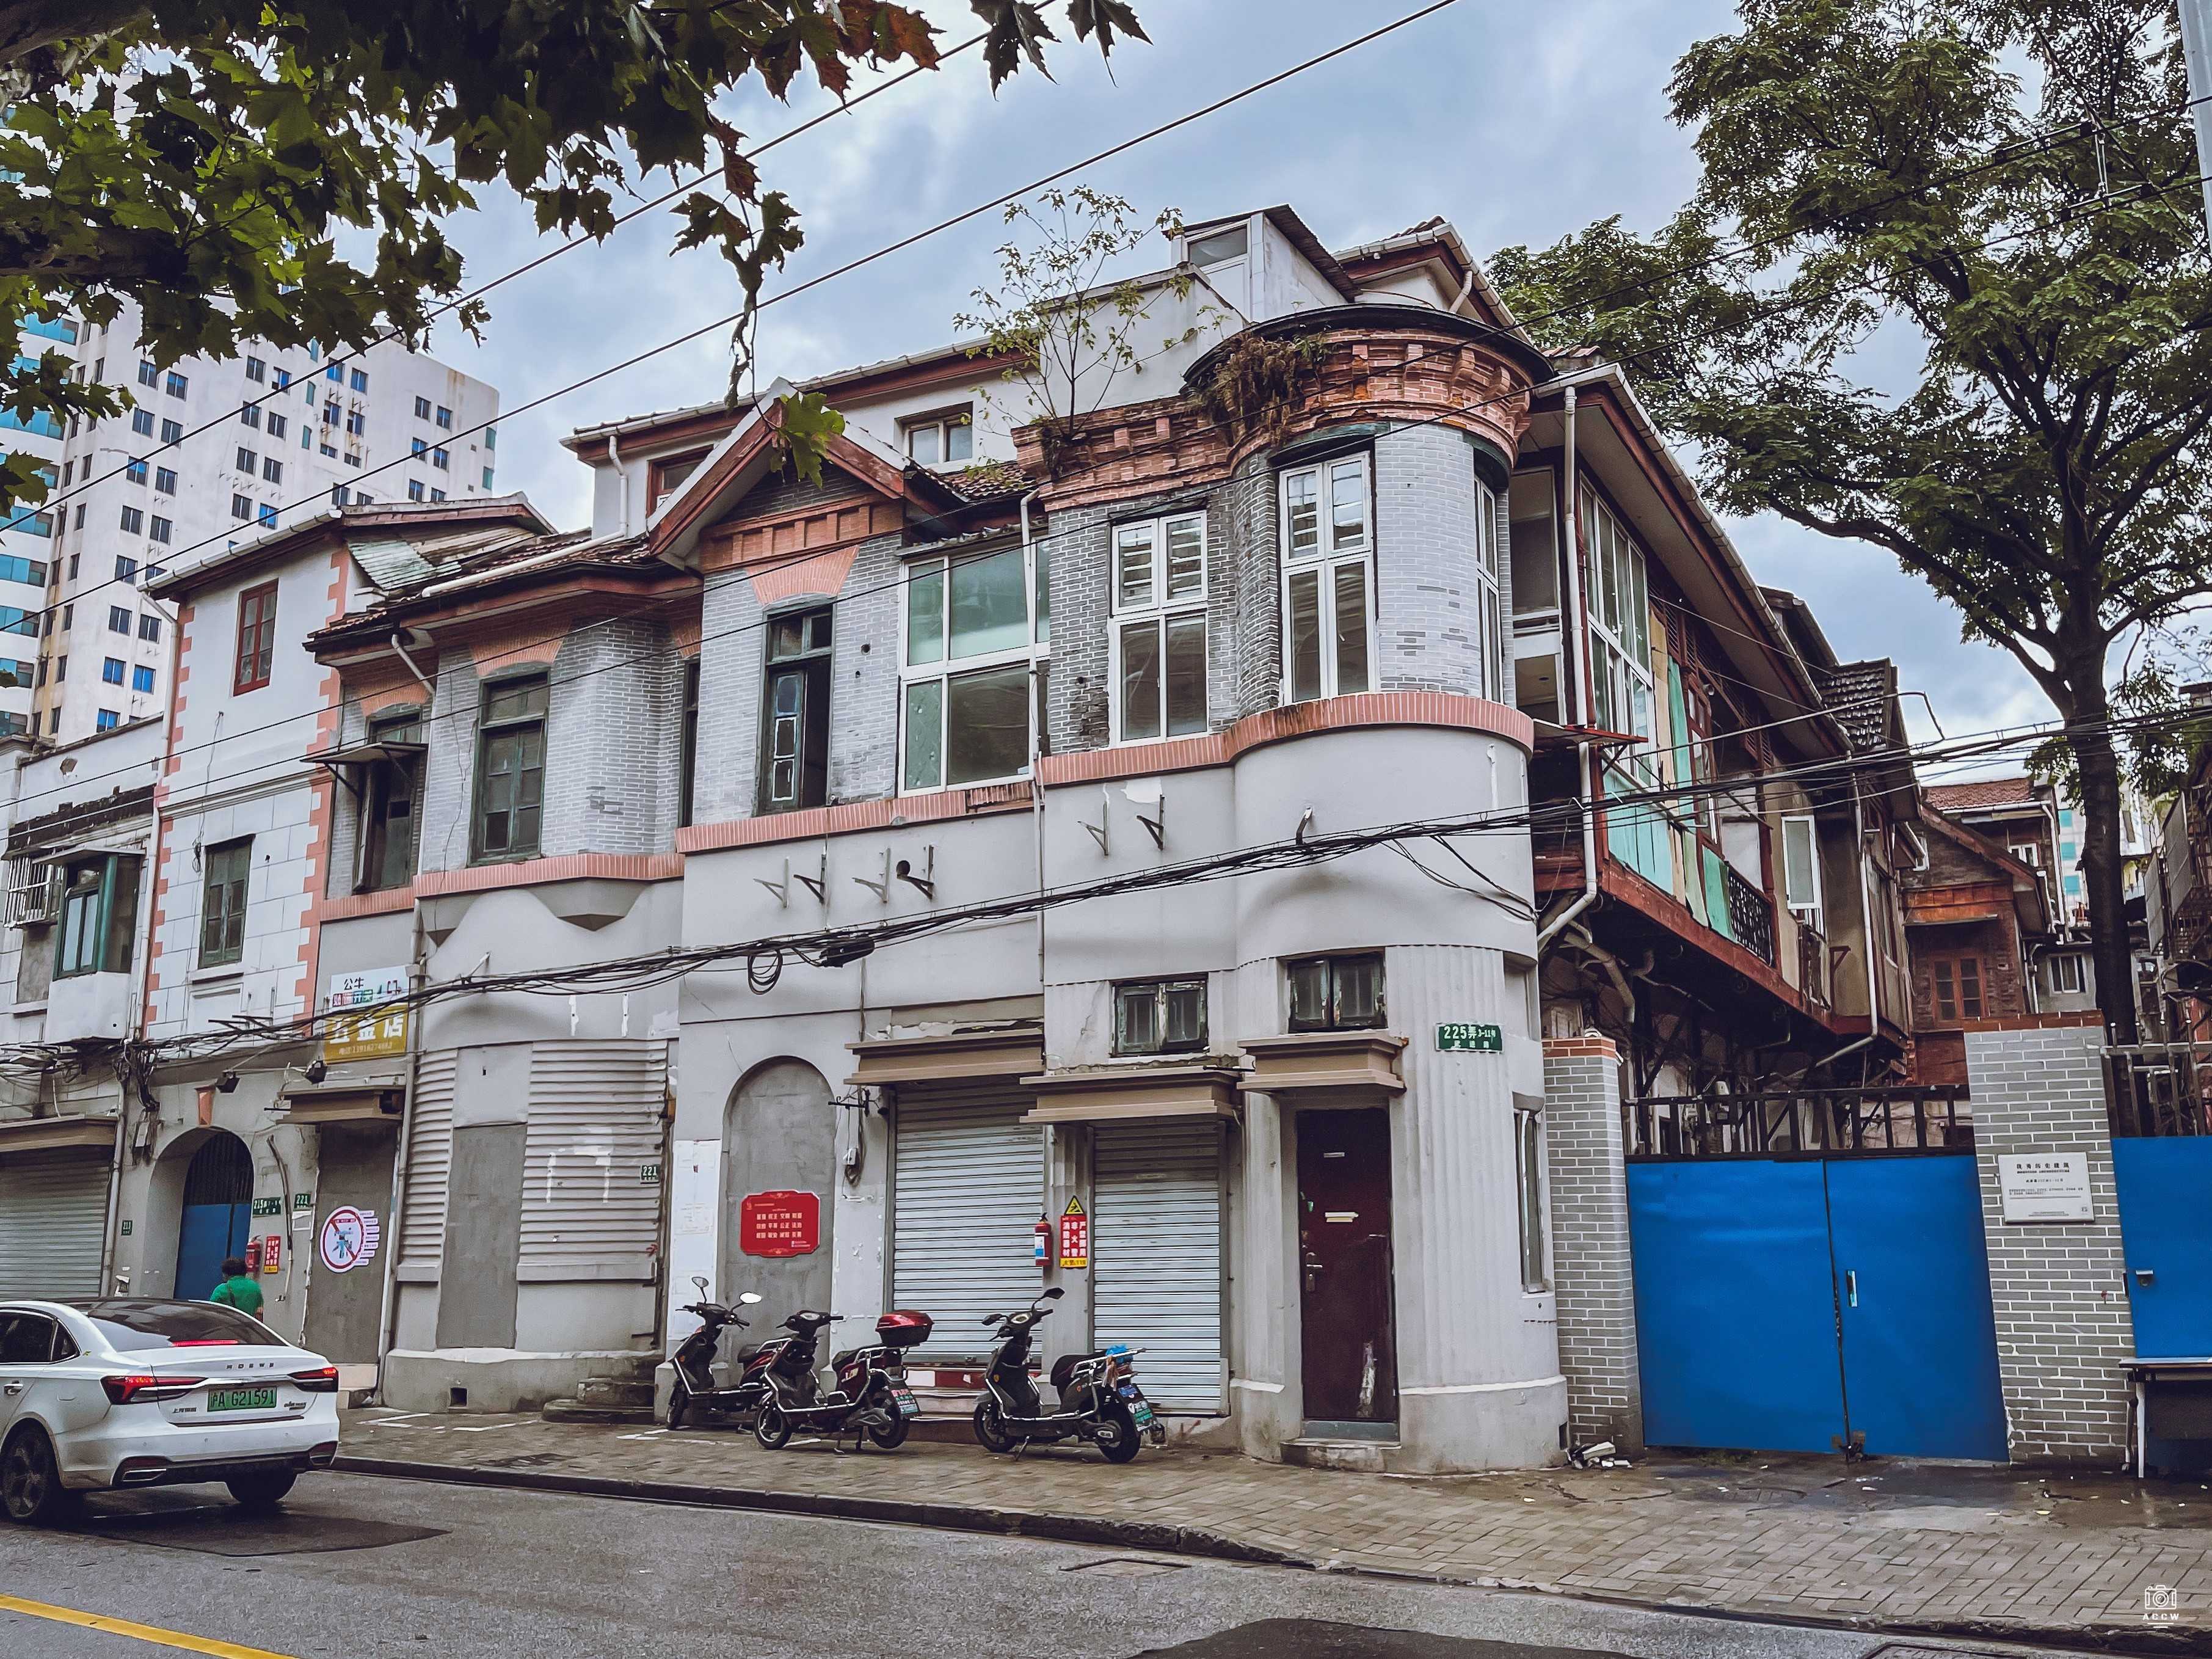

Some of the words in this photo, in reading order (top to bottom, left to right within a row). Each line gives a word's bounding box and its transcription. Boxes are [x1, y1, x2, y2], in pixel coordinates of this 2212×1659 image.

[344, 977, 365, 991] 公牛
[642, 1166, 657, 1176] 221
[296, 1195, 308, 1205] 221
